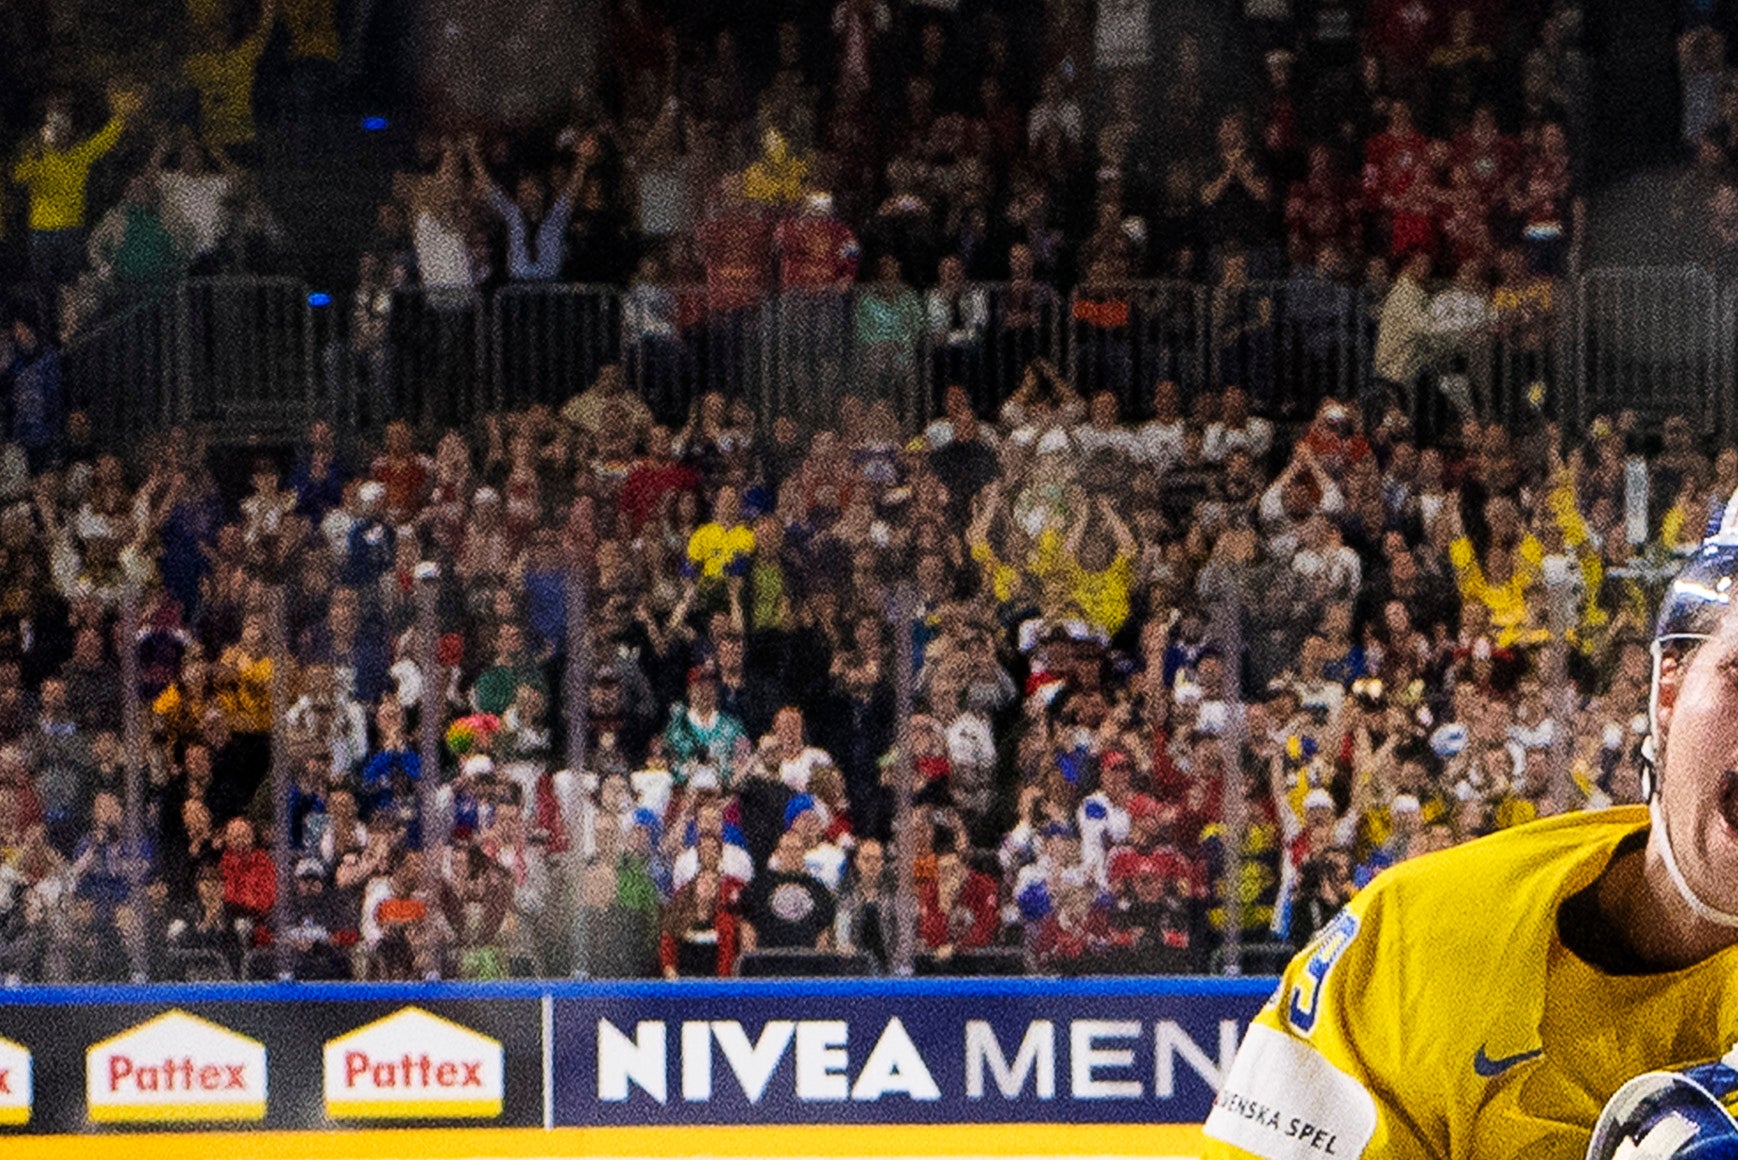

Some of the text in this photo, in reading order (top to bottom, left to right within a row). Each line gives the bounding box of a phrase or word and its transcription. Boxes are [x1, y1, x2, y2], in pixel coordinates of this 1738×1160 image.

[107, 1054, 247, 1092] Pattex
[343, 1050, 482, 1088] Pattex
[598, 1017, 1239, 1104] NIVEA MEN
[1284, 1118, 1337, 1155] SPEL
